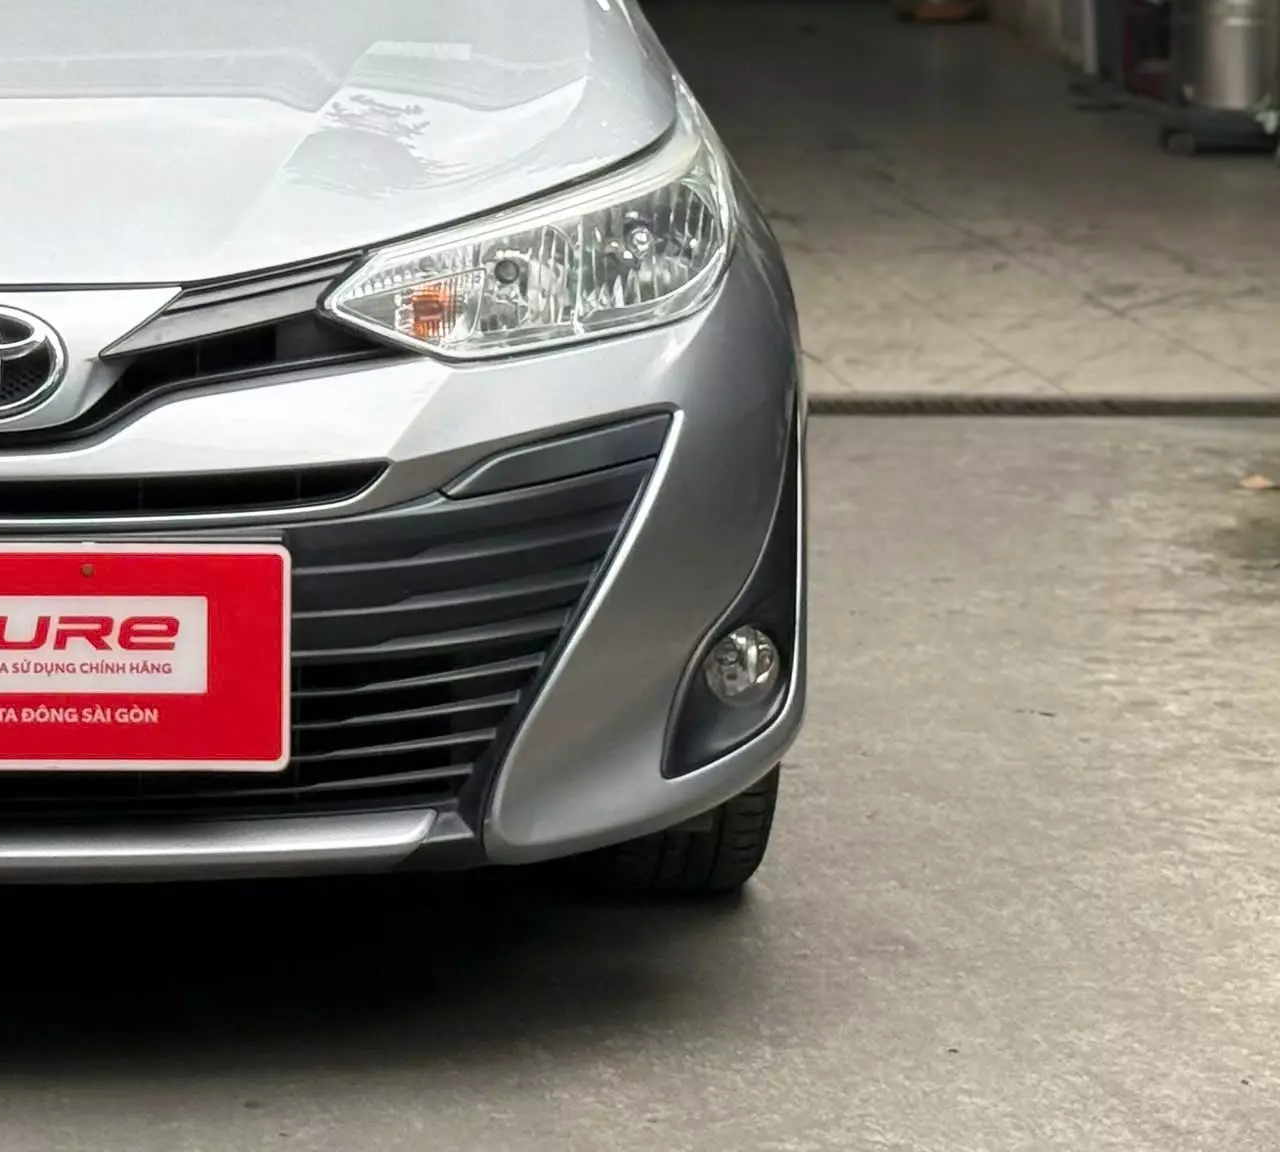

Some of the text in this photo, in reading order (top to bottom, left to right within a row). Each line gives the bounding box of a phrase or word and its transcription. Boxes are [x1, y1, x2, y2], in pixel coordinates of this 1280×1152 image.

[11, 658, 32, 674] SỬ
[34, 662, 77, 678] DỤNG
[80, 659, 127, 674] CHÍNH
[129, 660, 173, 675] HÃNG
[20, 703, 79, 724] ĐÔNG
[81, 703, 113, 724] SÀI
[115, 703, 159, 724] GÒN
